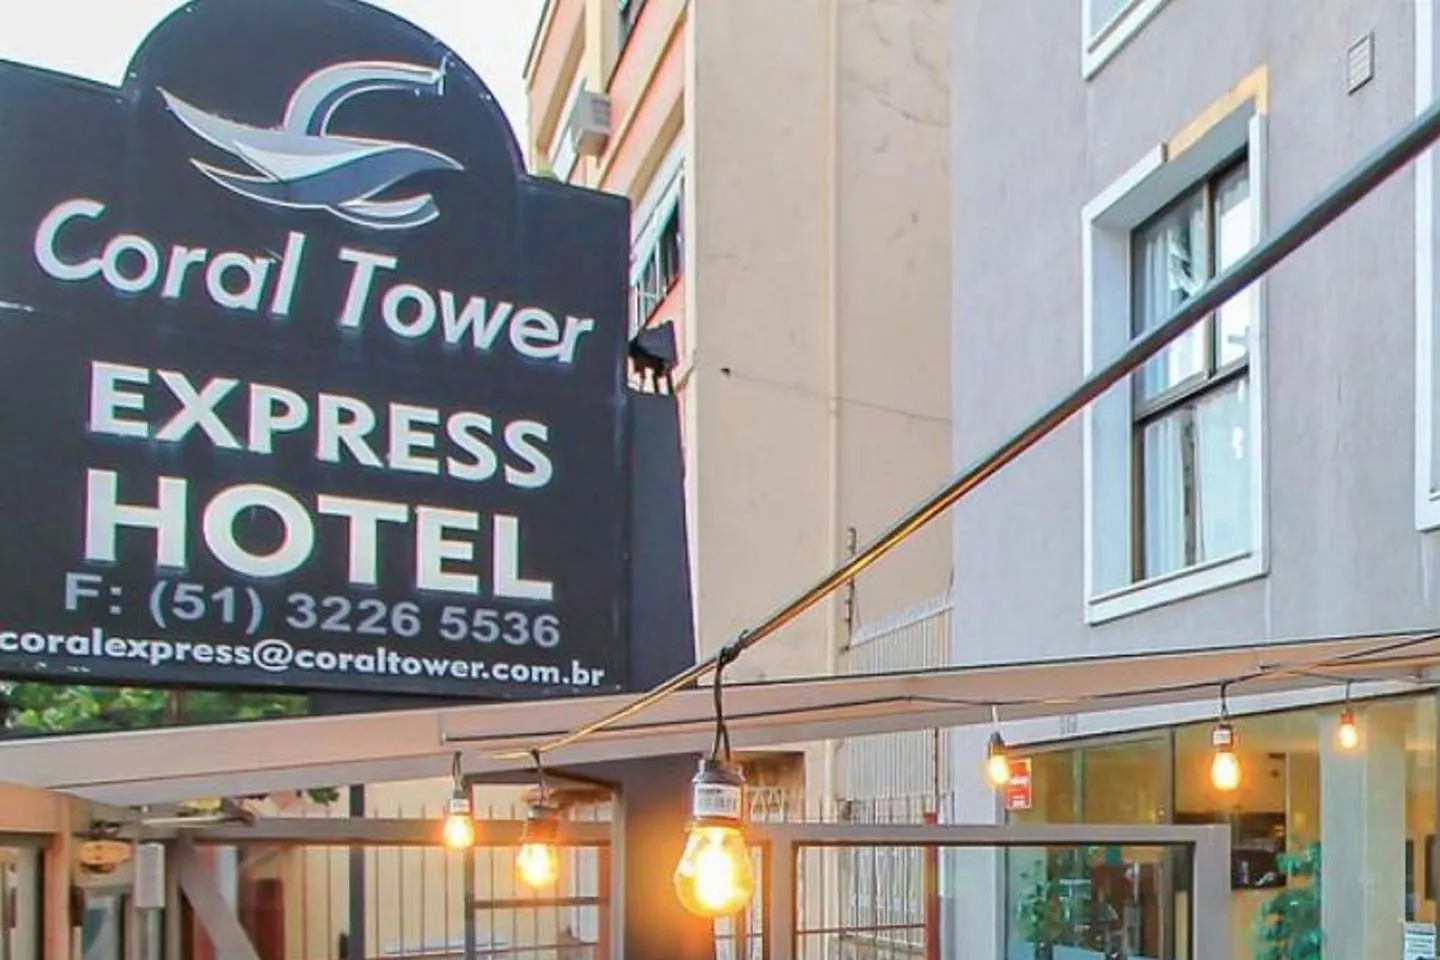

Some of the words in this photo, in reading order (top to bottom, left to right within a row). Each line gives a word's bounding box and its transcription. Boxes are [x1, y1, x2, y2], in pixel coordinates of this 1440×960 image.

[34, 199, 305, 317] Coral
[337, 247, 594, 365] Tower
[89, 360, 554, 488] EXPRESS
[84, 467, 554, 600] HOTEL
[0, 627, 605, 687] coralexpress@coraltower.com.br
[64, 571, 123, 615] F:
[150, 580, 263, 635] (51)
[286, 593, 421, 638] 3226
[438, 605, 561, 649] 5536
